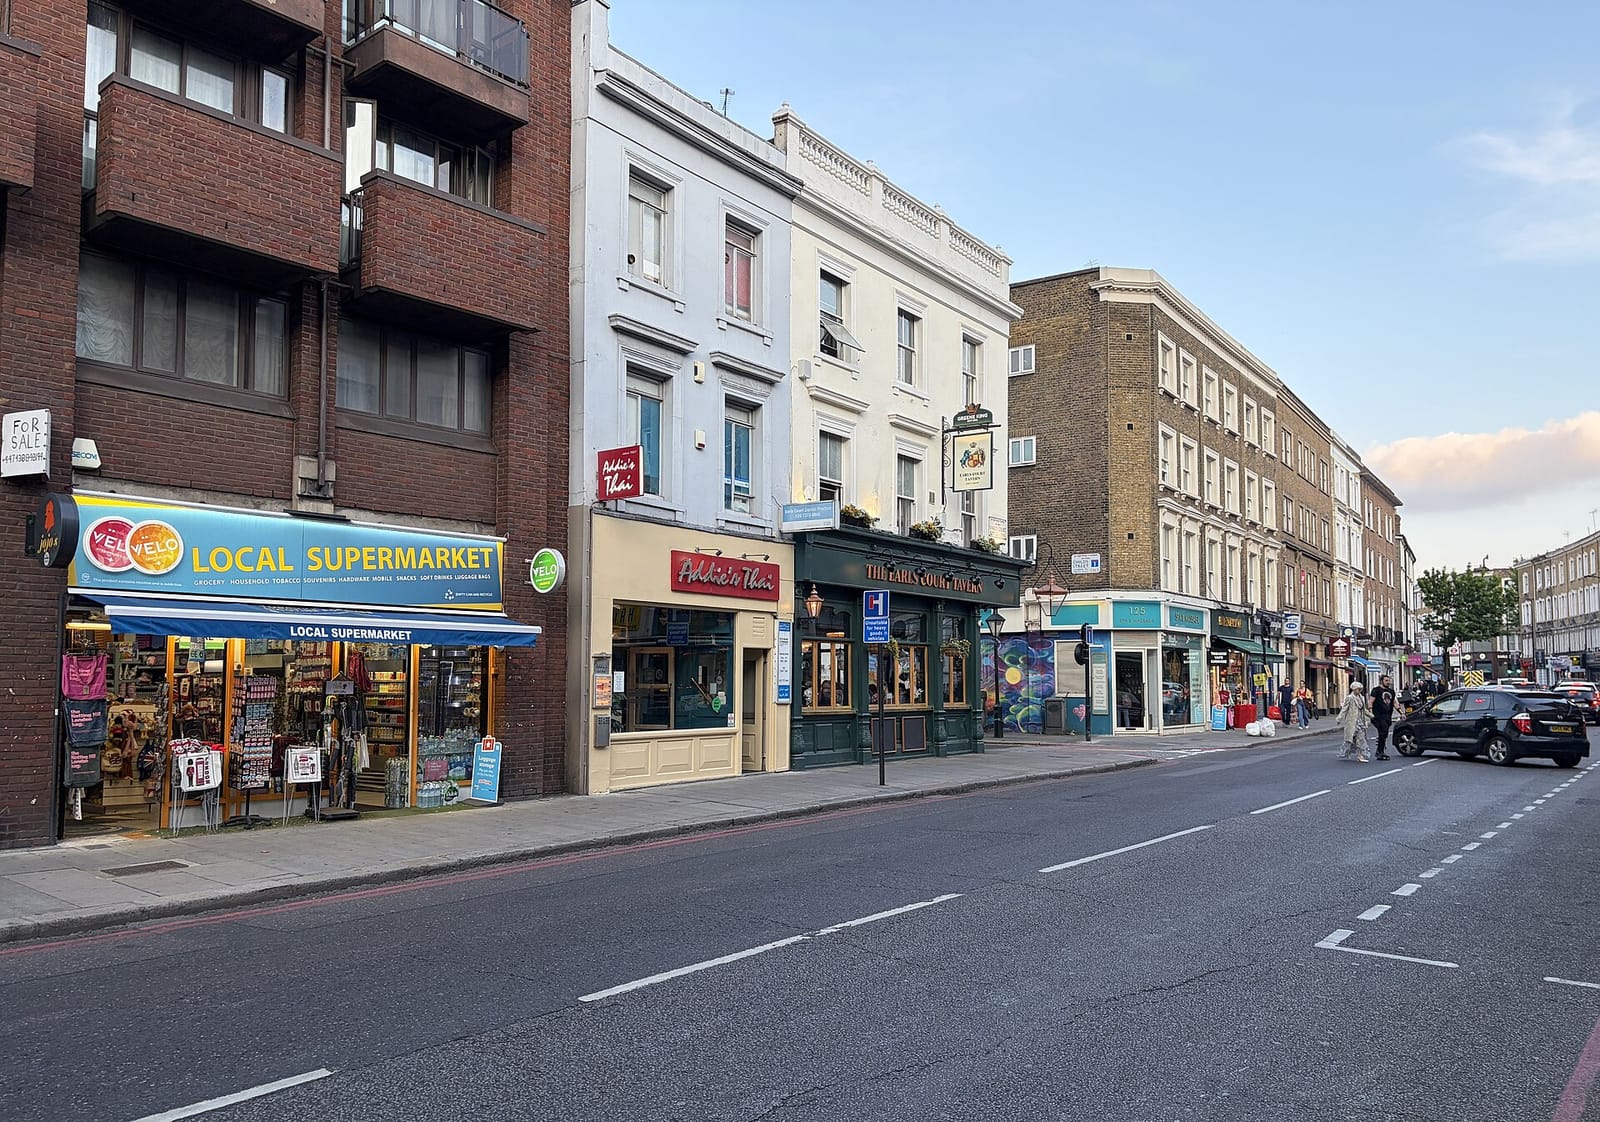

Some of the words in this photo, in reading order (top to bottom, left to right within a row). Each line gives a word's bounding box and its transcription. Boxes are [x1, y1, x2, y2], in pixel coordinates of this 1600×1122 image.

[13, 417, 39, 434] FOR
[11, 432, 41, 449] SALE
[603, 458, 636, 475] Addie's
[604, 473, 634, 496] Thai
[94, 529, 126, 553] VEL
[131, 537, 178, 557] VELO
[191, 546, 294, 573] LOCAL
[307, 546, 493, 572] SUPERMARKET
[532, 564, 557, 577] VELO
[678, 558, 741, 586] Addie's
[742, 566, 775, 590] Thai
[865, 563, 887, 580] THE
[1129, 606, 1146, 616] 125
[290, 626, 328, 638] LOCAL
[331, 627, 411, 641] SUPERMARKET
[478, 755, 497, 763] Luggage
